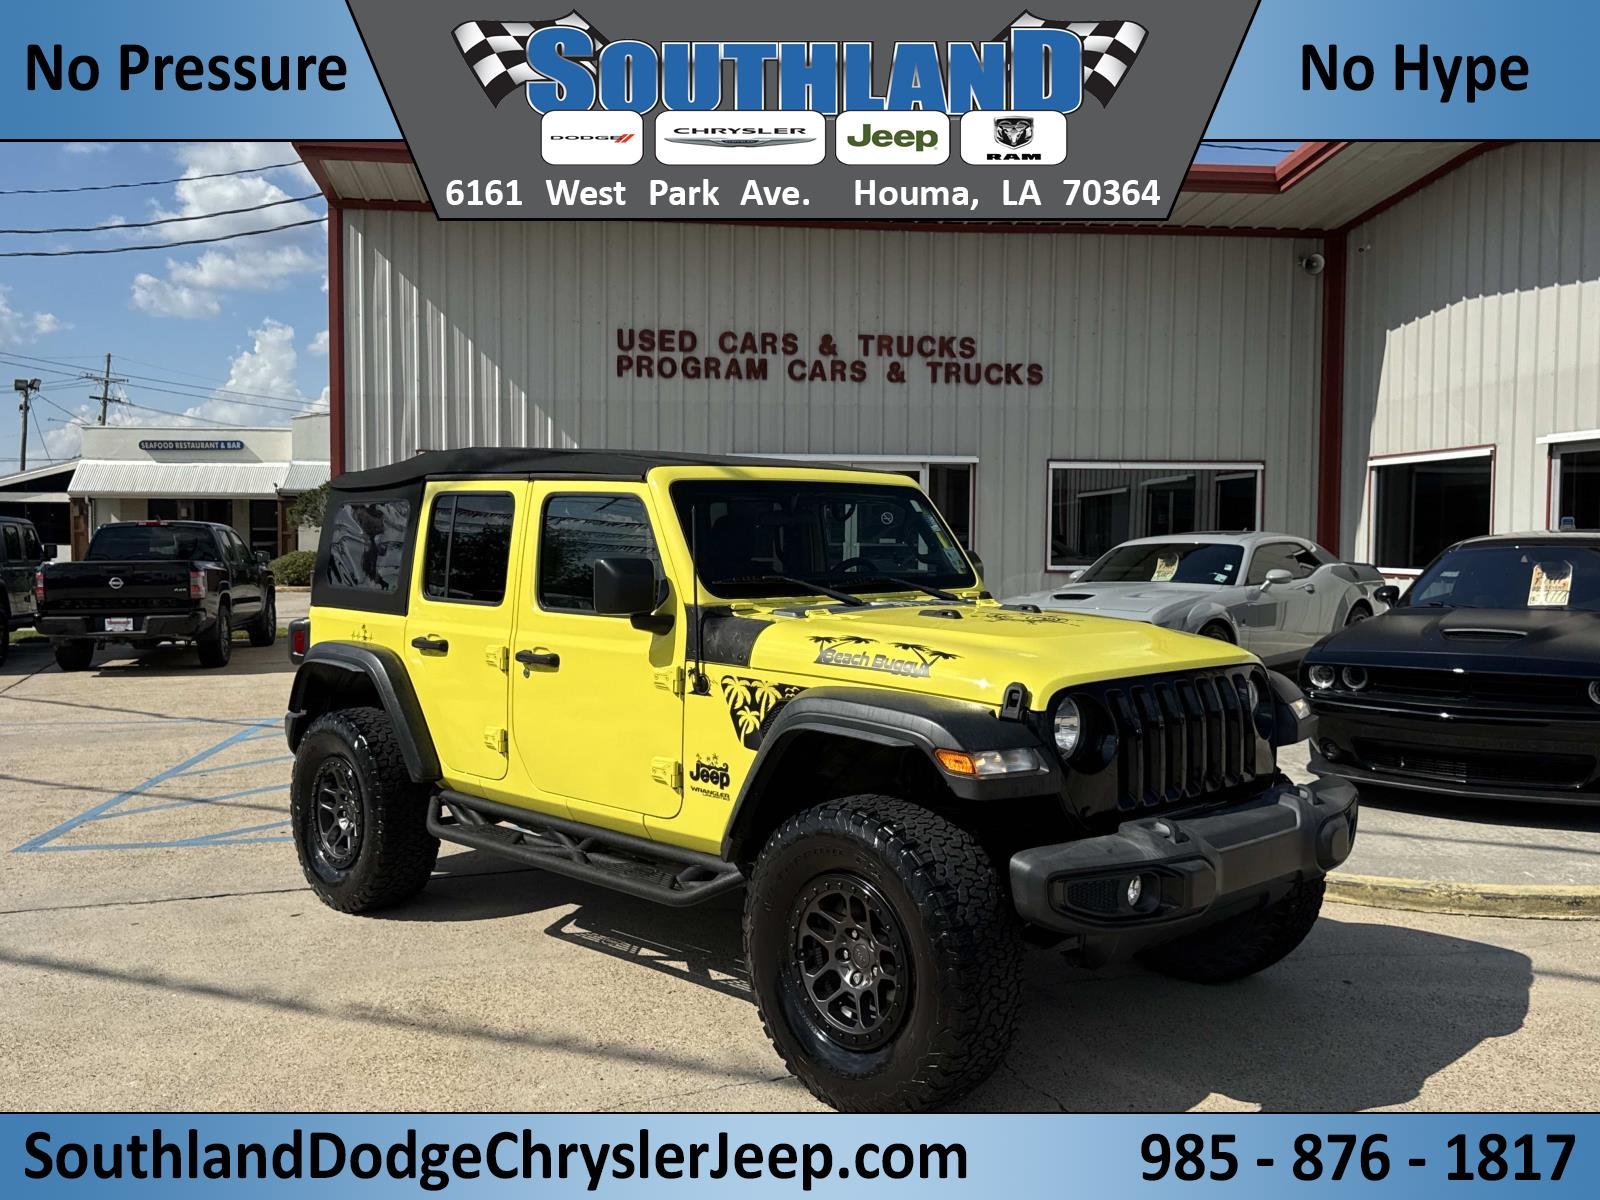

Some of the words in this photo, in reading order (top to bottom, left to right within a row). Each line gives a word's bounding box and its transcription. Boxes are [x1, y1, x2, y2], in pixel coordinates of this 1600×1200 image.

[617, 328, 697, 352] USED
[718, 331, 799, 355] CARS
[818, 334, 837, 357] &
[858, 334, 977, 359] TRUCKS
[616, 355, 769, 380] PROGRAM
[787, 359, 867, 382] CARS
[887, 361, 906, 384] &
[926, 361, 1043, 386] TRUCKS
[141, 441, 174, 449] SEAFOOD
[175, 441, 219, 449] RESTAURANT
[227, 441, 241, 449] BAR
[823, 648, 870, 668] Beach
[689, 760, 730, 790] Jeep
[690, 785, 730, 799] WRANGLER
